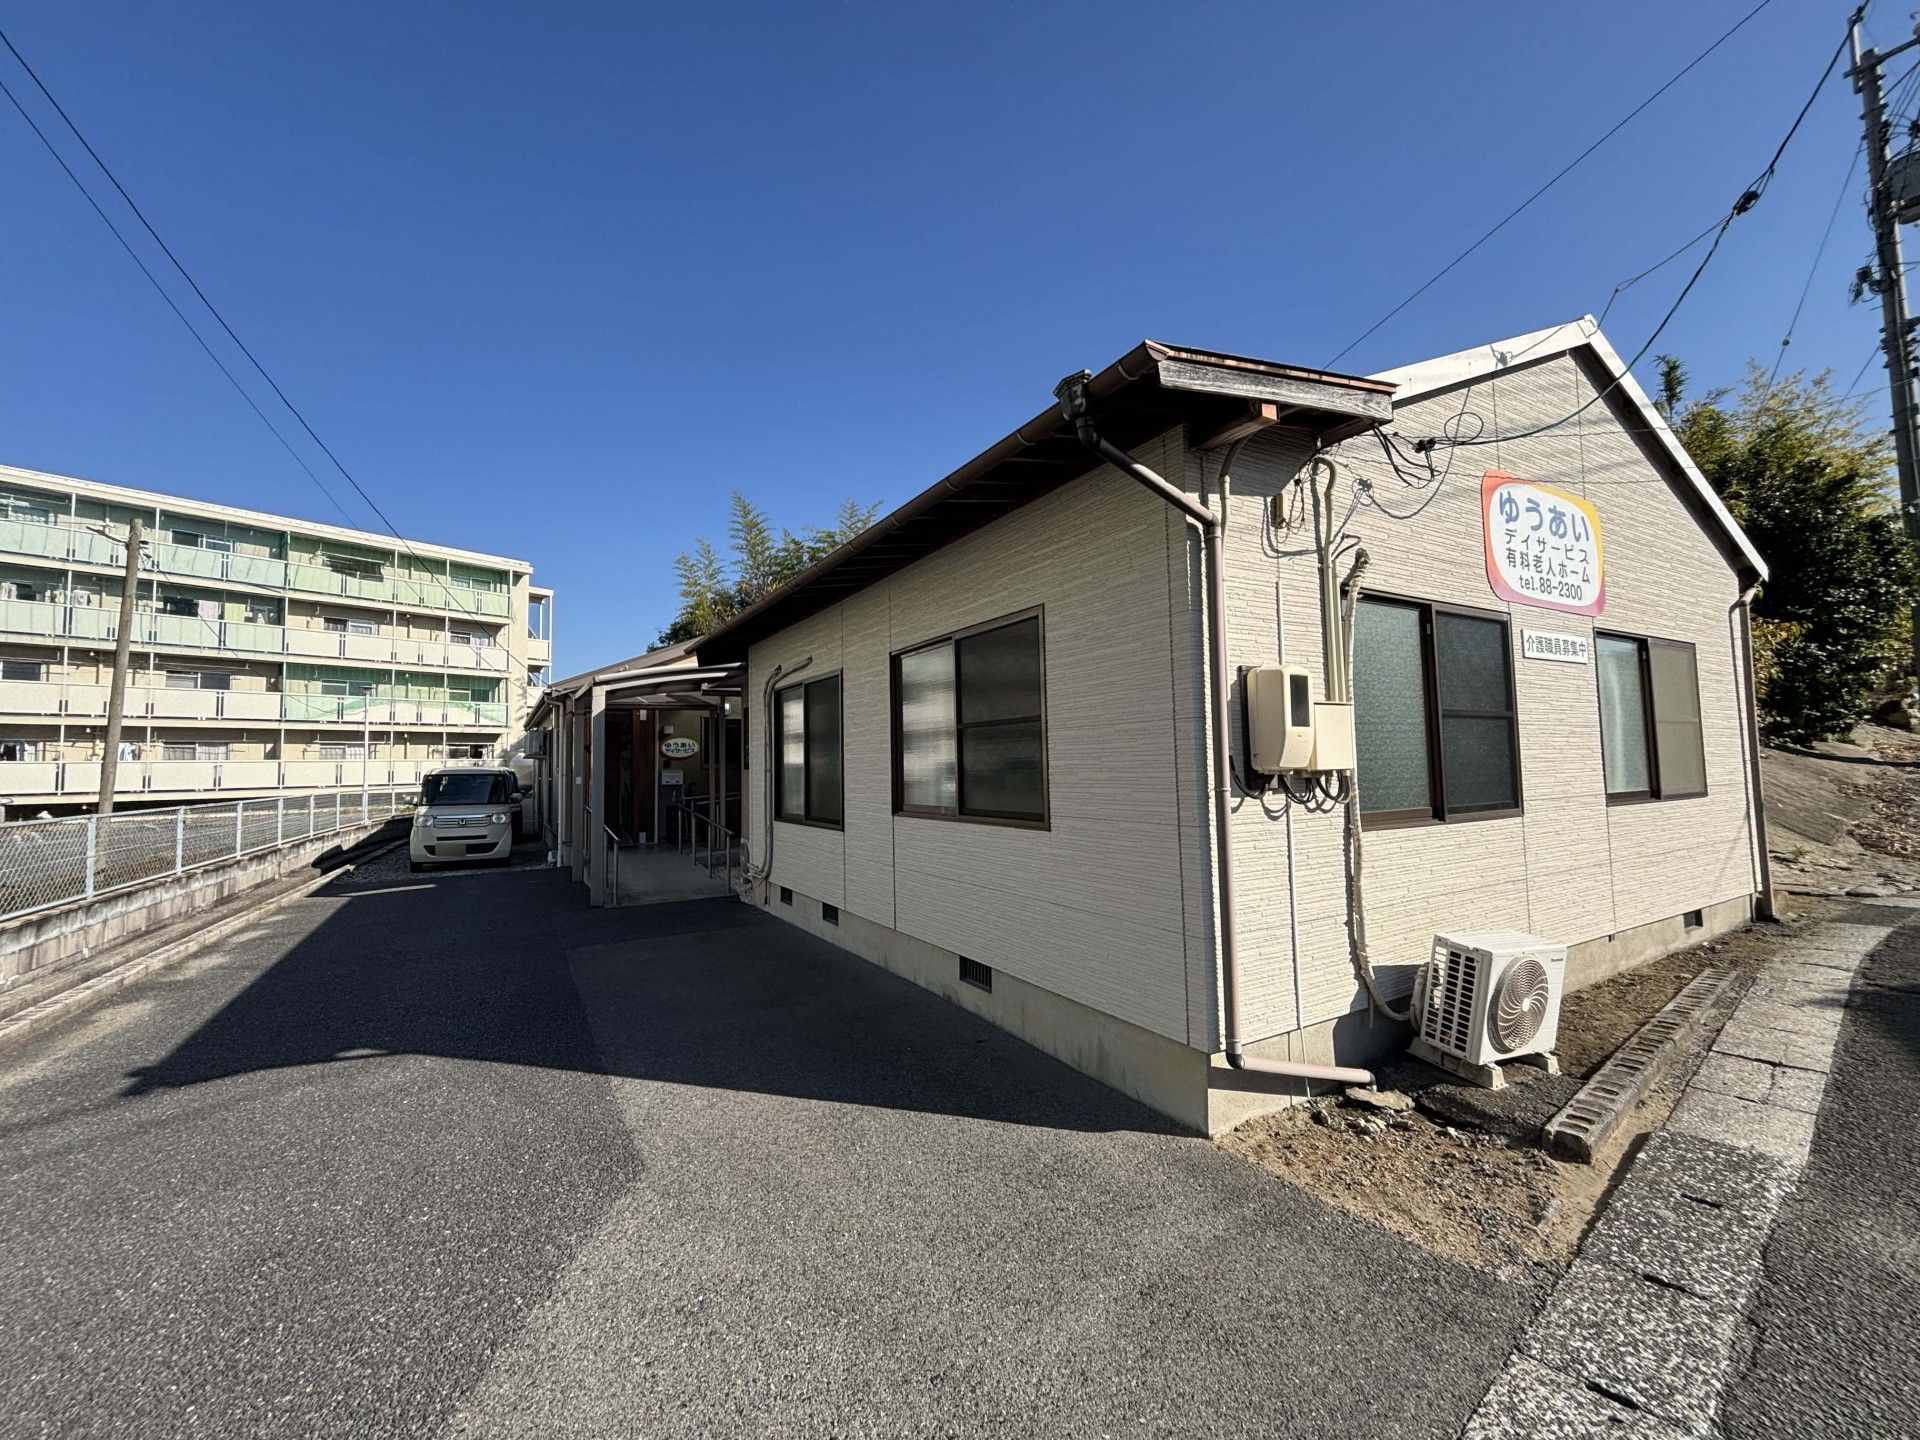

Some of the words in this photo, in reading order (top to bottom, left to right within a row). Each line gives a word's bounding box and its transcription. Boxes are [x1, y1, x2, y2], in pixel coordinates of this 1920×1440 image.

[1499, 491, 1590, 543] ゆうあい
[1504, 528, 1590, 565] デイサービス
[1506, 547, 1591, 584] 有料老人ホーム
[1519, 575, 1583, 601] tel.88-2300
[1526, 634, 1586, 657] 介護職員募集中
